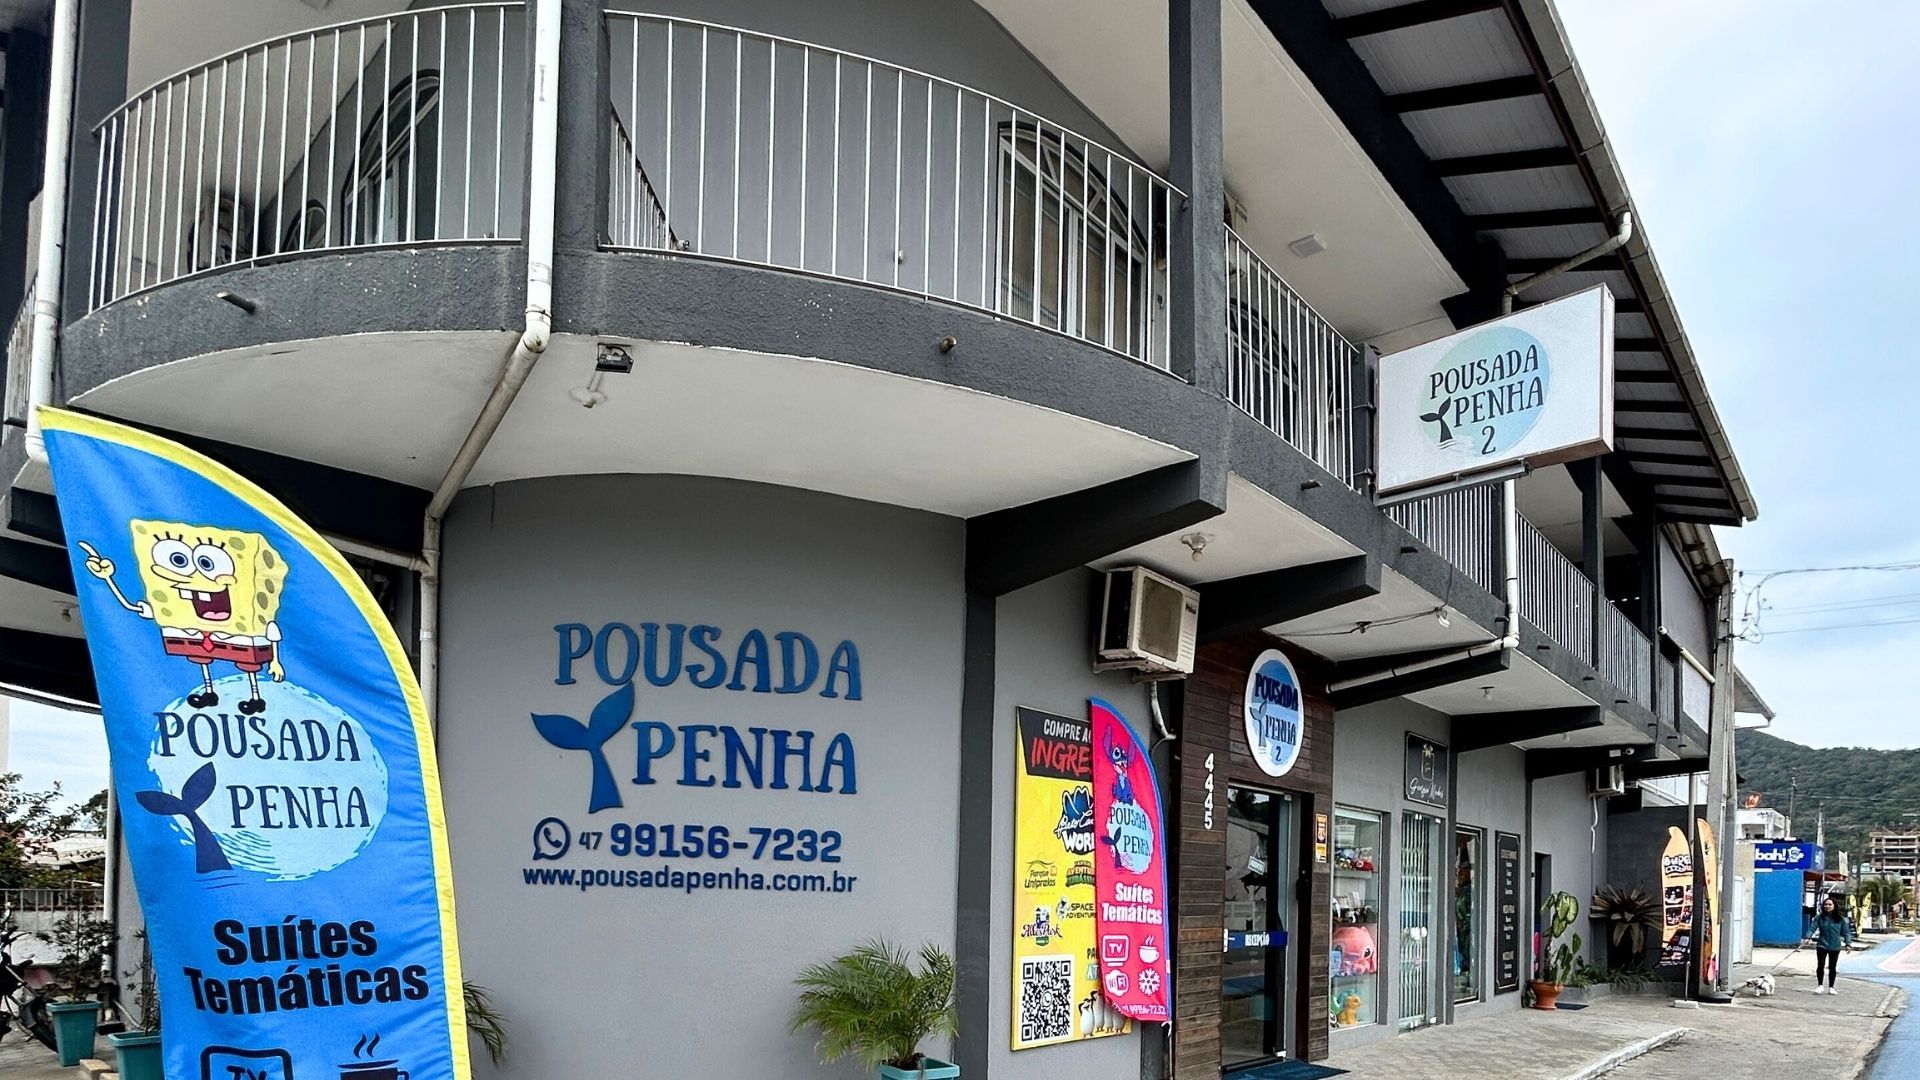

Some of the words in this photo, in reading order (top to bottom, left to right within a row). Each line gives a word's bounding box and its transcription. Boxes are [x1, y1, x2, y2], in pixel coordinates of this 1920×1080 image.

[1430, 344, 1539, 400] POUSADA
[1453, 376, 1544, 428] PENHA
[1481, 425, 1496, 455] 2
[554, 622, 862, 700] POUSADA
[1255, 672, 1299, 712] POUSADA
[153, 710, 361, 763] POUSADA
[1043, 718, 1081, 741] COMPRE
[1265, 714, 1297, 746] PENHA
[631, 721, 857, 794] PENHA
[1031, 737, 1092, 777] INGRE
[1275, 745, 1281, 762] 2
[226, 783, 371, 829] PENHA
[1203, 753, 1215, 830] 4445
[579, 831, 602, 850] 47
[610, 823, 842, 863] 99156-7232
[523, 865, 857, 893] www.pousadapenha.com.br
[1115, 881, 1154, 905] Suítes
[1070, 903, 1094, 911] SPACE
[1102, 902, 1163, 925] Temáticas
[213, 912, 378, 966] Suítes
[1109, 943, 1123, 955] TV
[184, 960, 429, 1017] Temáticas
